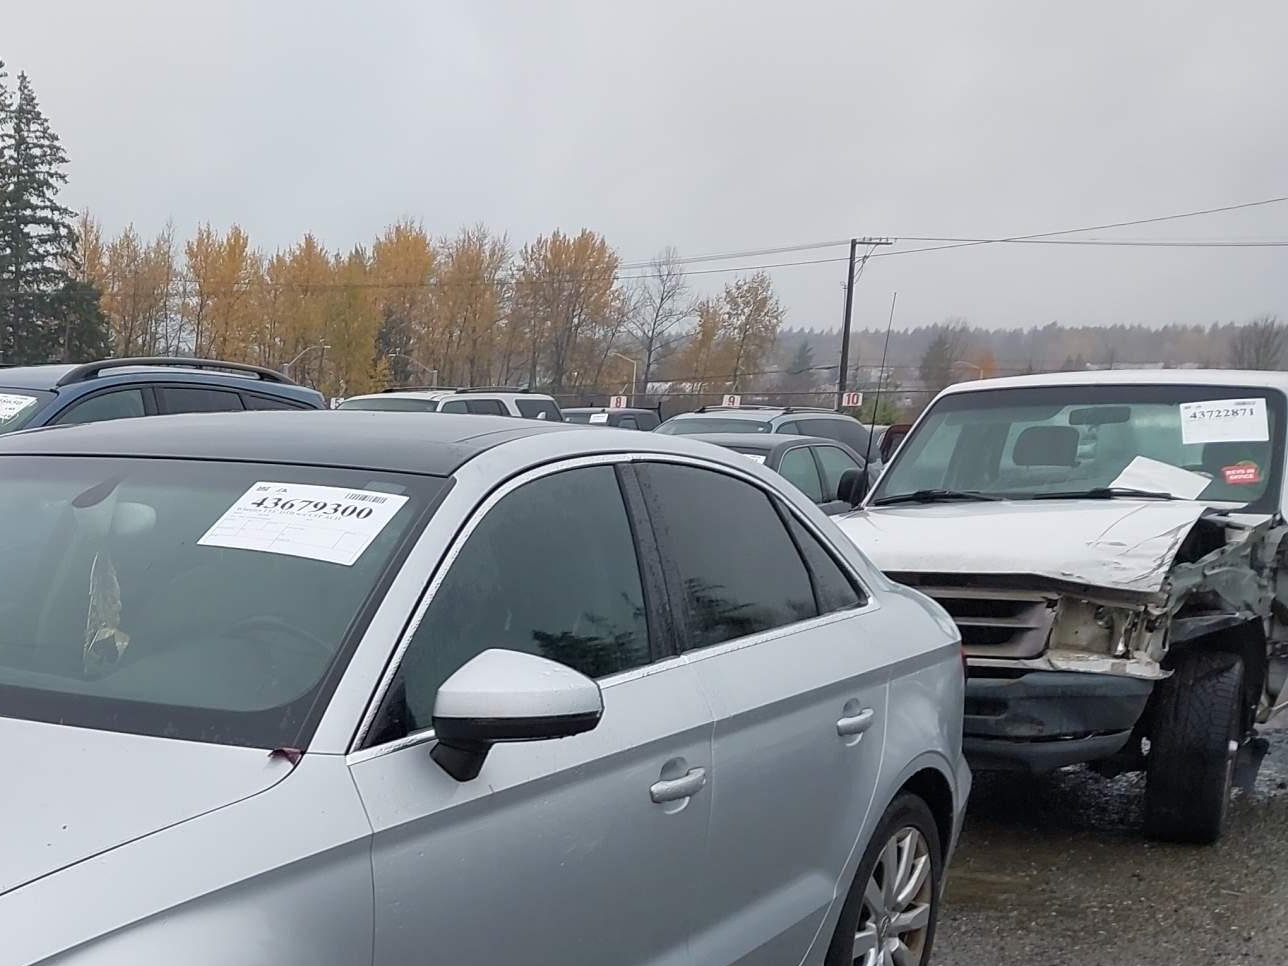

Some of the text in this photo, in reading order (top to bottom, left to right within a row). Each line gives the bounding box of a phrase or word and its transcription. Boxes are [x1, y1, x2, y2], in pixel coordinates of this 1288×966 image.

[846, 393, 859, 405] 10
[1190, 408, 1254, 418] 43722871
[252, 496, 373, 519] 43679300
